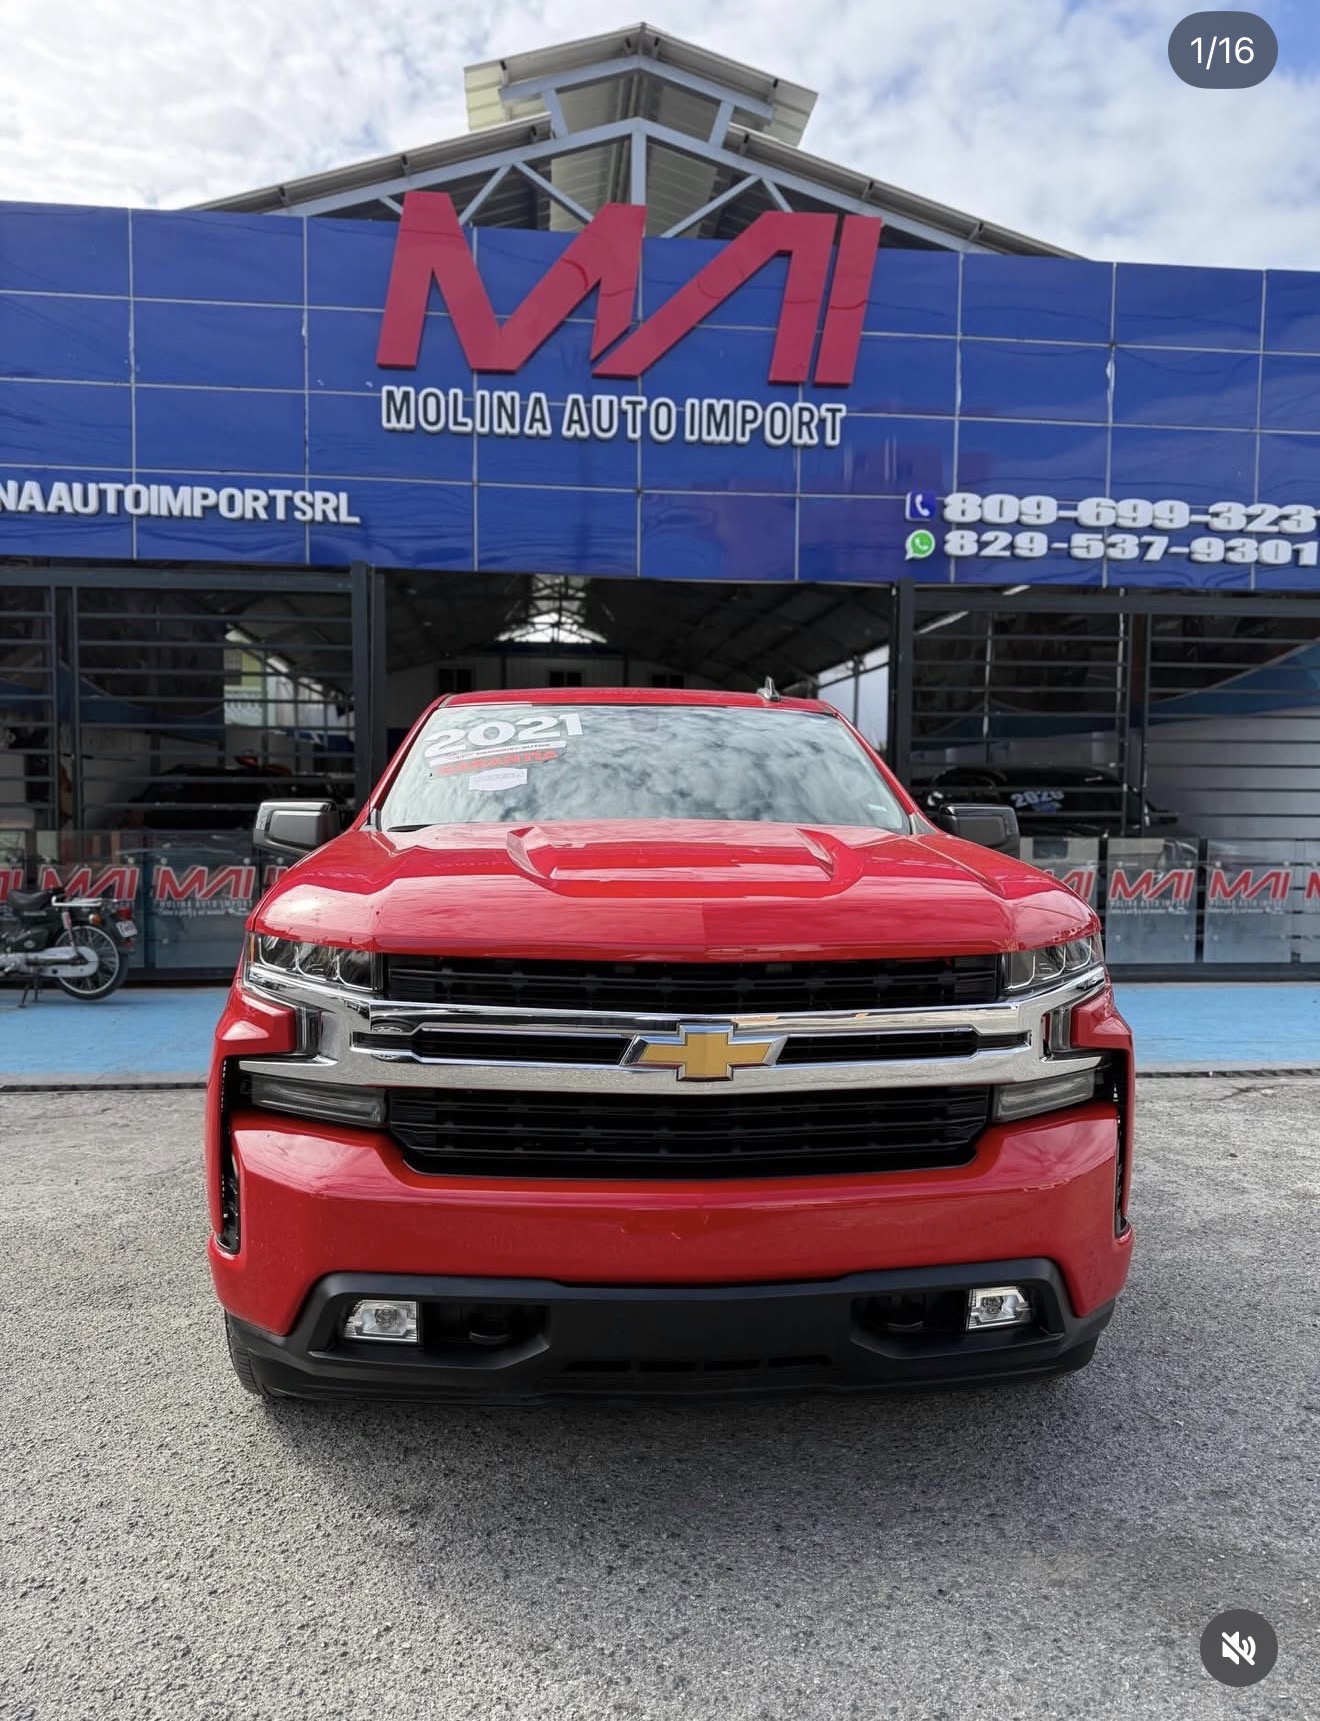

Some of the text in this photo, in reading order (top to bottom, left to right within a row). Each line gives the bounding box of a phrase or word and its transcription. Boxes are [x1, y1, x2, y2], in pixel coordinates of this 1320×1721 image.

[376, 191, 883, 387] MAI
[381, 385, 847, 446] MOLINA AUTO IMPORT
[943, 492, 1320, 534] 809-699-323
[944, 530, 1319, 566] 829-537-9301
[424, 713, 584, 758] 2021
[155, 865, 256, 900] MAI
[1109, 869, 1196, 901] MAI
[1208, 869, 1292, 900] MAI
